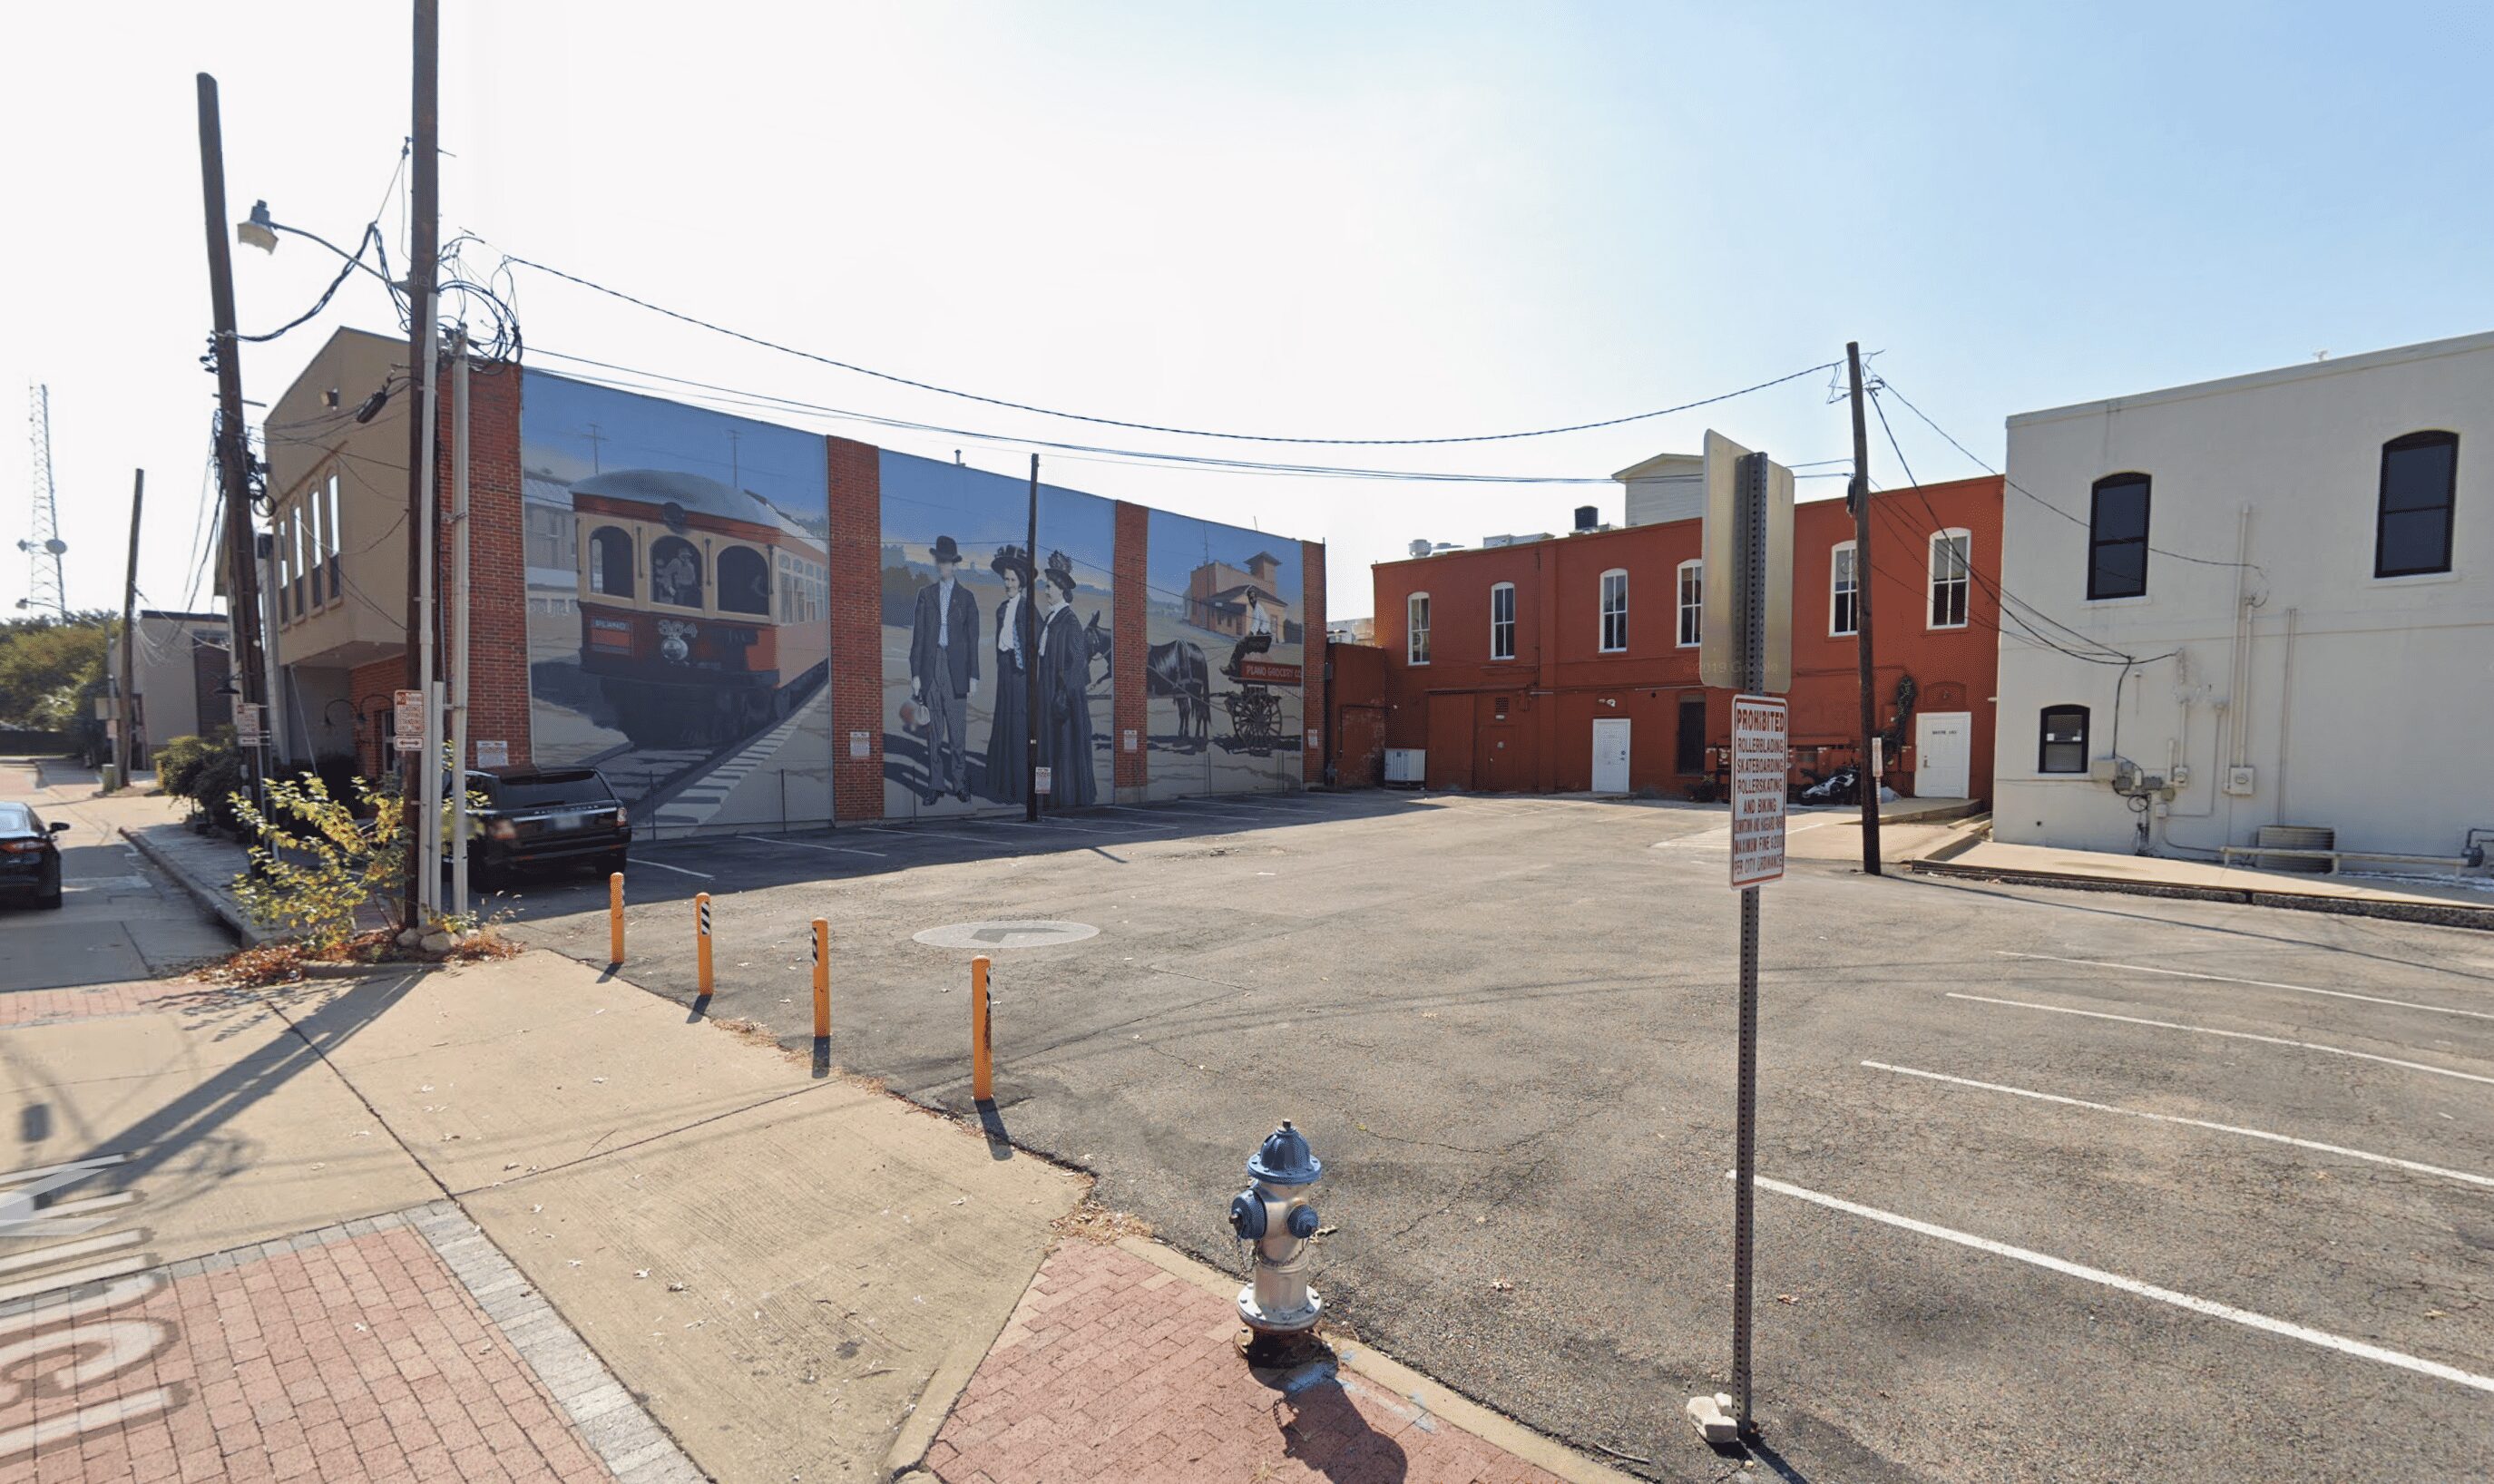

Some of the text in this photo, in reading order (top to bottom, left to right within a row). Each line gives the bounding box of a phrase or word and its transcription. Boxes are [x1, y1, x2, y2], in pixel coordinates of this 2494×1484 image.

[1246, 665, 1267, 677] PLANO
[1267, 668, 1294, 679] GROCERY
[1736, 708, 1785, 732] PROHIBITED
[1737, 737, 1784, 754] ROLLERBLADING
[1736, 758, 1784, 774] SKATEBOARDING
[1737, 778, 1783, 795] ROLLERSKATING
[1743, 798, 1776, 815] AND BIKING
[1734, 838, 1757, 855] MAXIMUM
[1759, 835, 1769, 852] FINE
[1735, 853, 1782, 875] PER CITY ORDINANCE
